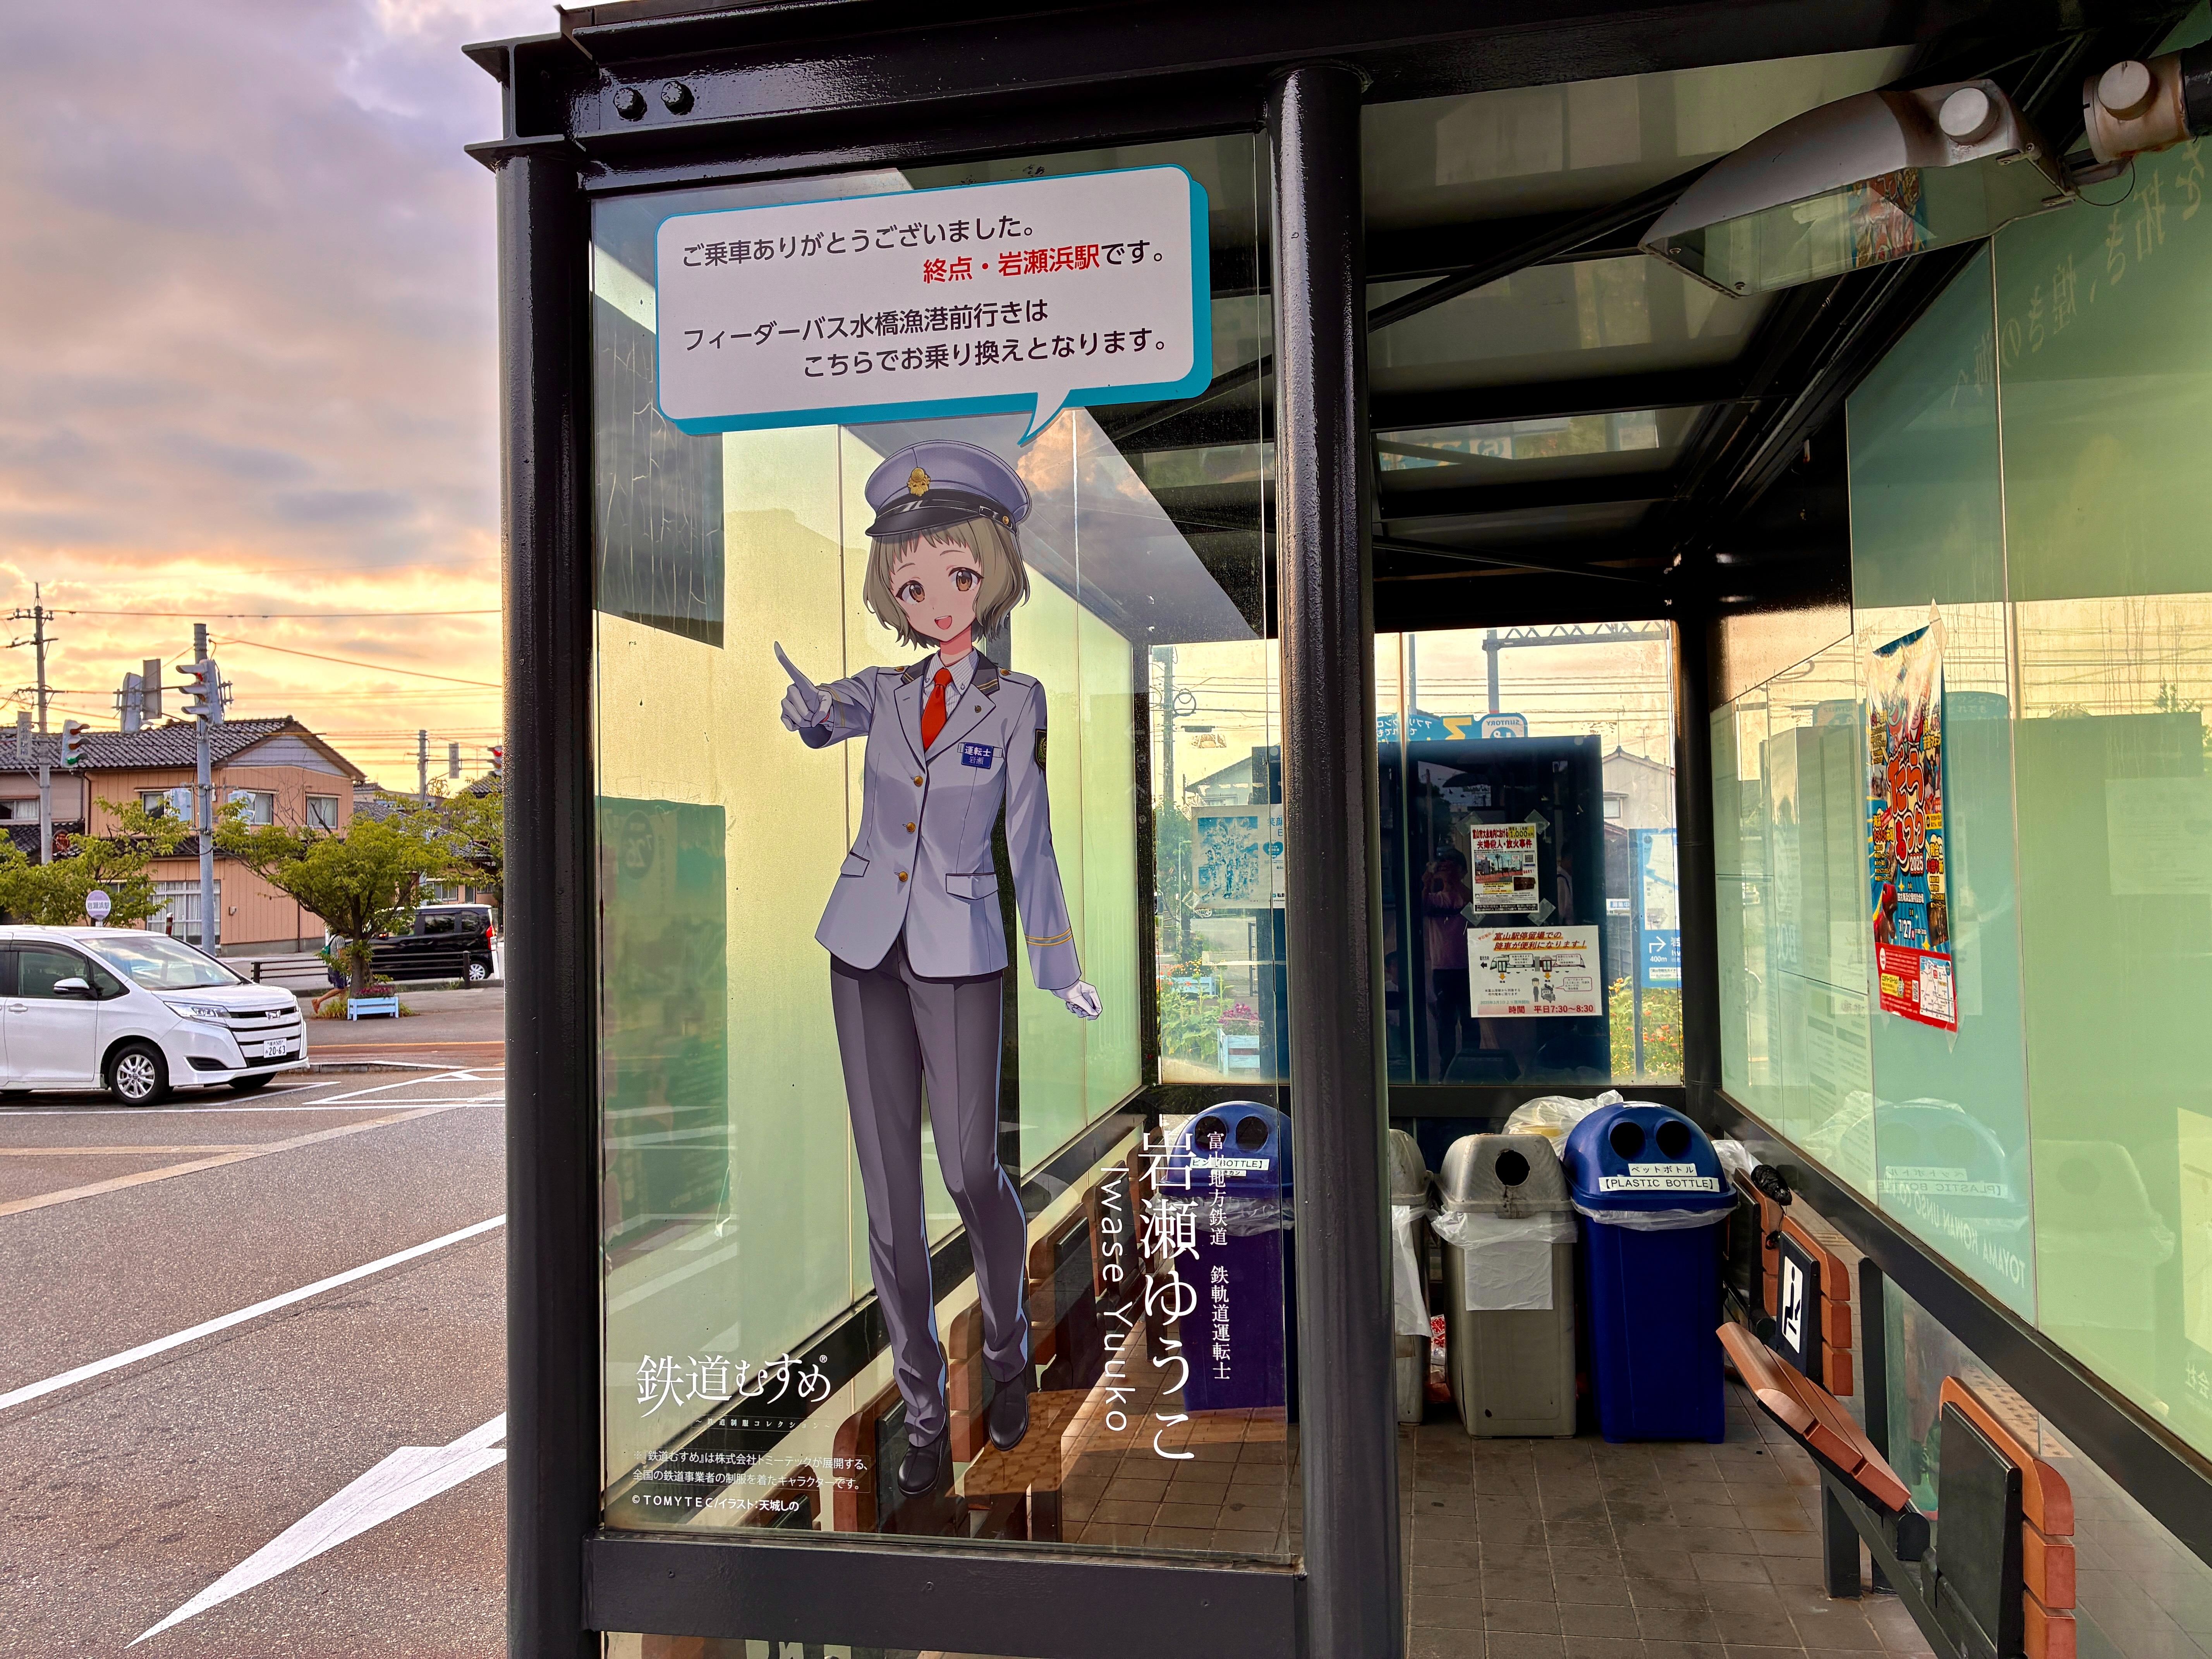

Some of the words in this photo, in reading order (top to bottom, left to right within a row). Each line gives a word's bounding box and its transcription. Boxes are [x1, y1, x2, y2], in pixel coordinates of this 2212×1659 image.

[683, 215, 1035, 269] ご乗車ありがとうございました。
[923, 240, 1163, 283] 終点・岩瀬浜駅です。
[684, 299, 1048, 350] フィーダーバス水橋漁港前行きは
[805, 327, 1164, 378] こちらでお乗り換えとなります。
[965, 745, 991, 757] 運転士
[969, 756, 984, 765] 岩瀬
[1910, 853, 1923, 871] 2025
[1494, 931, 1562, 941] 富山駅停留場での
[1494, 940, 1586, 950] 降車が便利になります！
[1508, 1006, 1525, 1014] 時間
[1631, 1165, 1694, 1174] ペットボトル
[1207, 1132, 1228, 1247] 富山地方鉄道
[1101, 1168, 1129, 1283] Iwase
[1211, 1265, 1231, 1380] 鉄軌道運転士
[1104, 1301, 1135, 1432] Yuuko
[632, 1470, 860, 1490] 全国の鉄道事業者の制服を着たキャラクターです。
